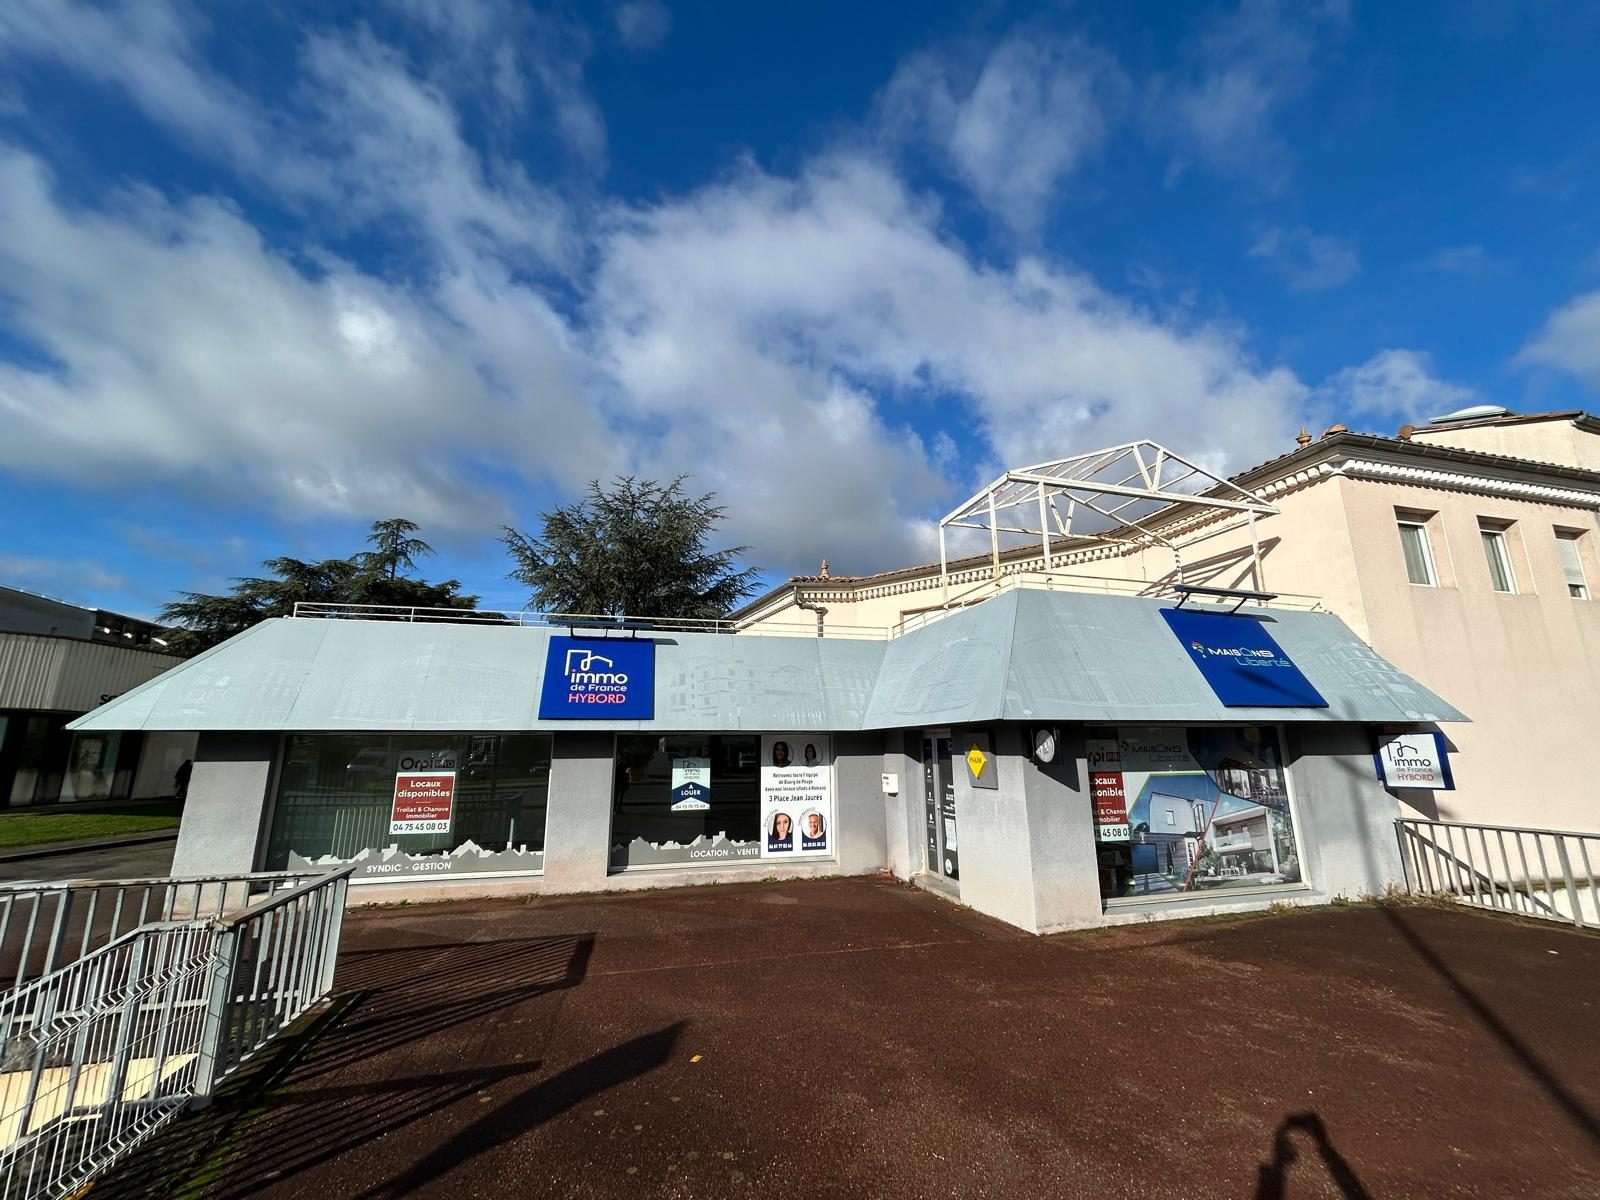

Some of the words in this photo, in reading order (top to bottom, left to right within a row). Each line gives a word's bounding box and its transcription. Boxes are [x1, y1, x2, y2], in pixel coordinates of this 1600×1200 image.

[1208, 647, 1274, 657] MAISONS
[1235, 657, 1292, 667] Liberté
[571, 668, 628, 684] immo
[588, 684, 628, 692] France
[568, 693, 626, 703] HYBORD
[401, 756, 433, 772] Orpi
[1393, 756, 1431, 766] immo
[410, 780, 441, 788] Locaux
[398, 790, 450, 798] disponibles
[1102, 829, 1110, 837] 45
[690, 849, 728, 858] LOCATION
[366, 864, 402, 873] SYNDIC
[412, 862, 452, 871] GESTION
